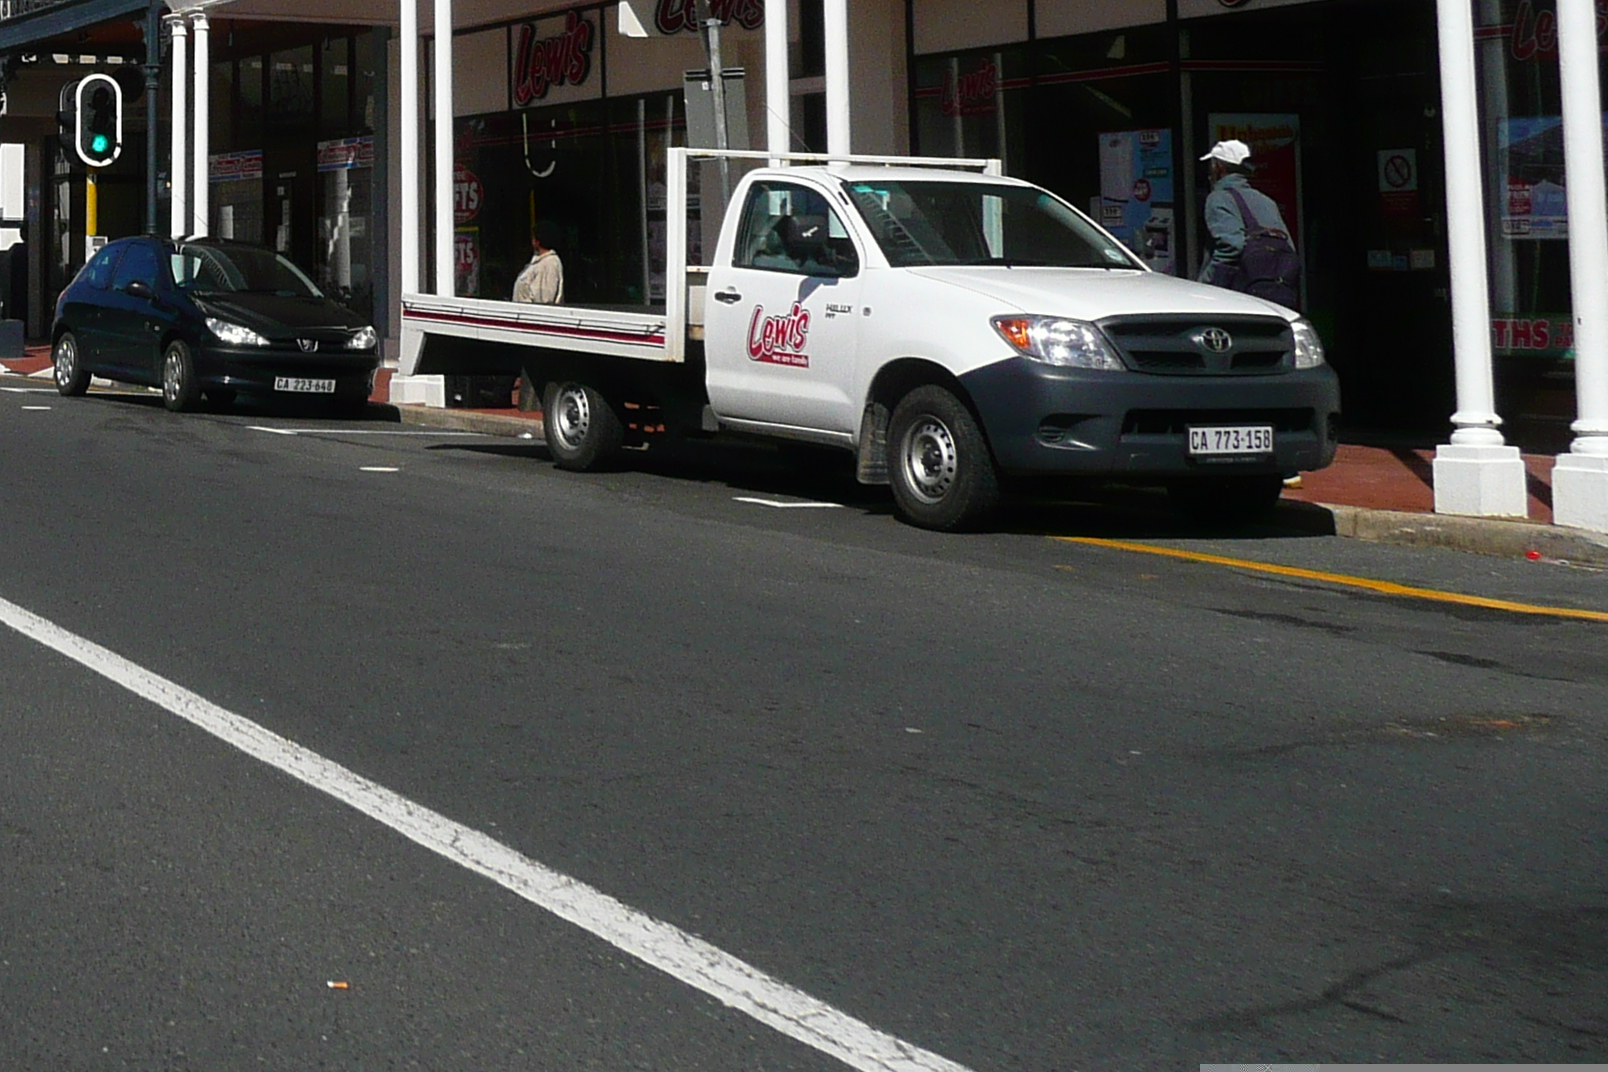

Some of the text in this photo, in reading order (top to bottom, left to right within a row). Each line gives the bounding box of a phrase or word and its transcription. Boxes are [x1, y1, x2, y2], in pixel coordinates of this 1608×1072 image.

[514, 10, 592, 106] Lewis
[940, 58, 998, 115] Lewis
[453, 181, 479, 210] FTS
[825, 303, 853, 314] HILUX
[747, 301, 810, 360] Lewis
[1492, 318, 1550, 349] THS
[276, 378, 289, 390] CA
[1191, 429, 1271, 450] CA 773-158
